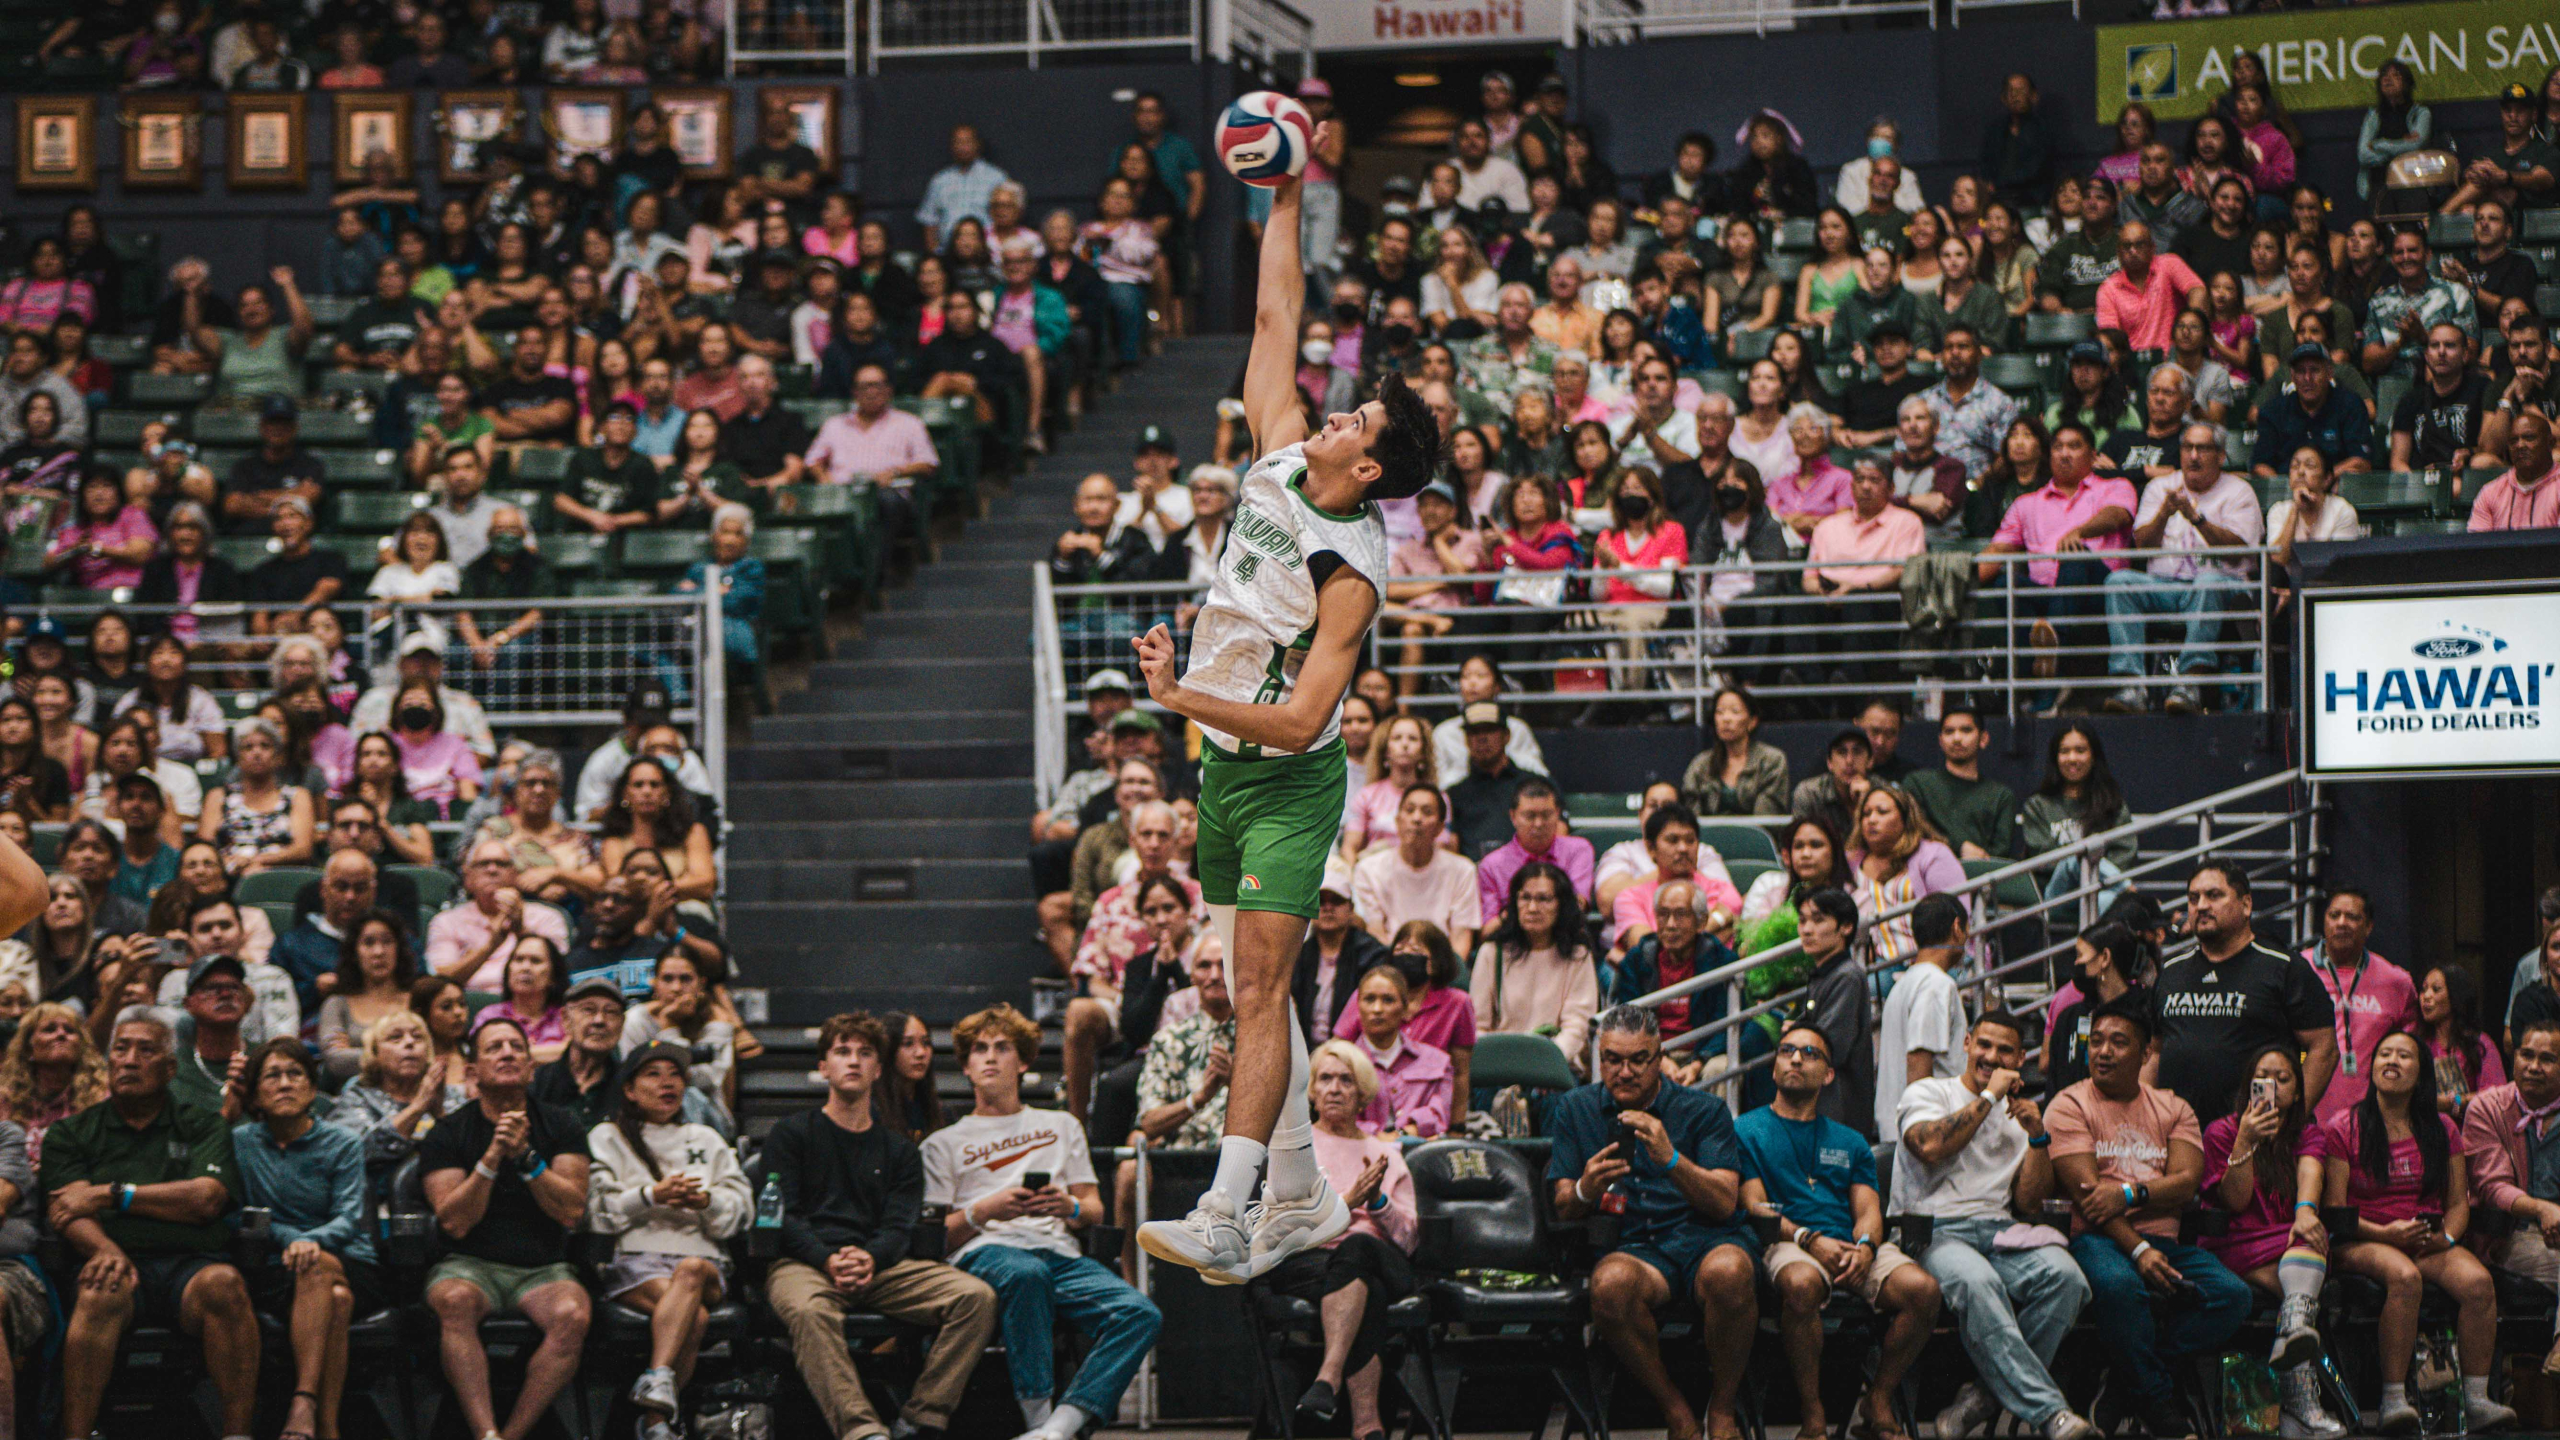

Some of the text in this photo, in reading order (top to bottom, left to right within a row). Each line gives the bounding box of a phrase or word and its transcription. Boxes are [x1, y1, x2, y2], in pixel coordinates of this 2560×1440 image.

[1232, 552, 1265, 585] 4
[2425, 638, 2470, 658] Ford
[2357, 711, 2541, 734] FORD DEALERS
[2162, 1006, 2242, 1018] CHEERLEADING
[963, 1129, 1054, 1166] Syracuse
